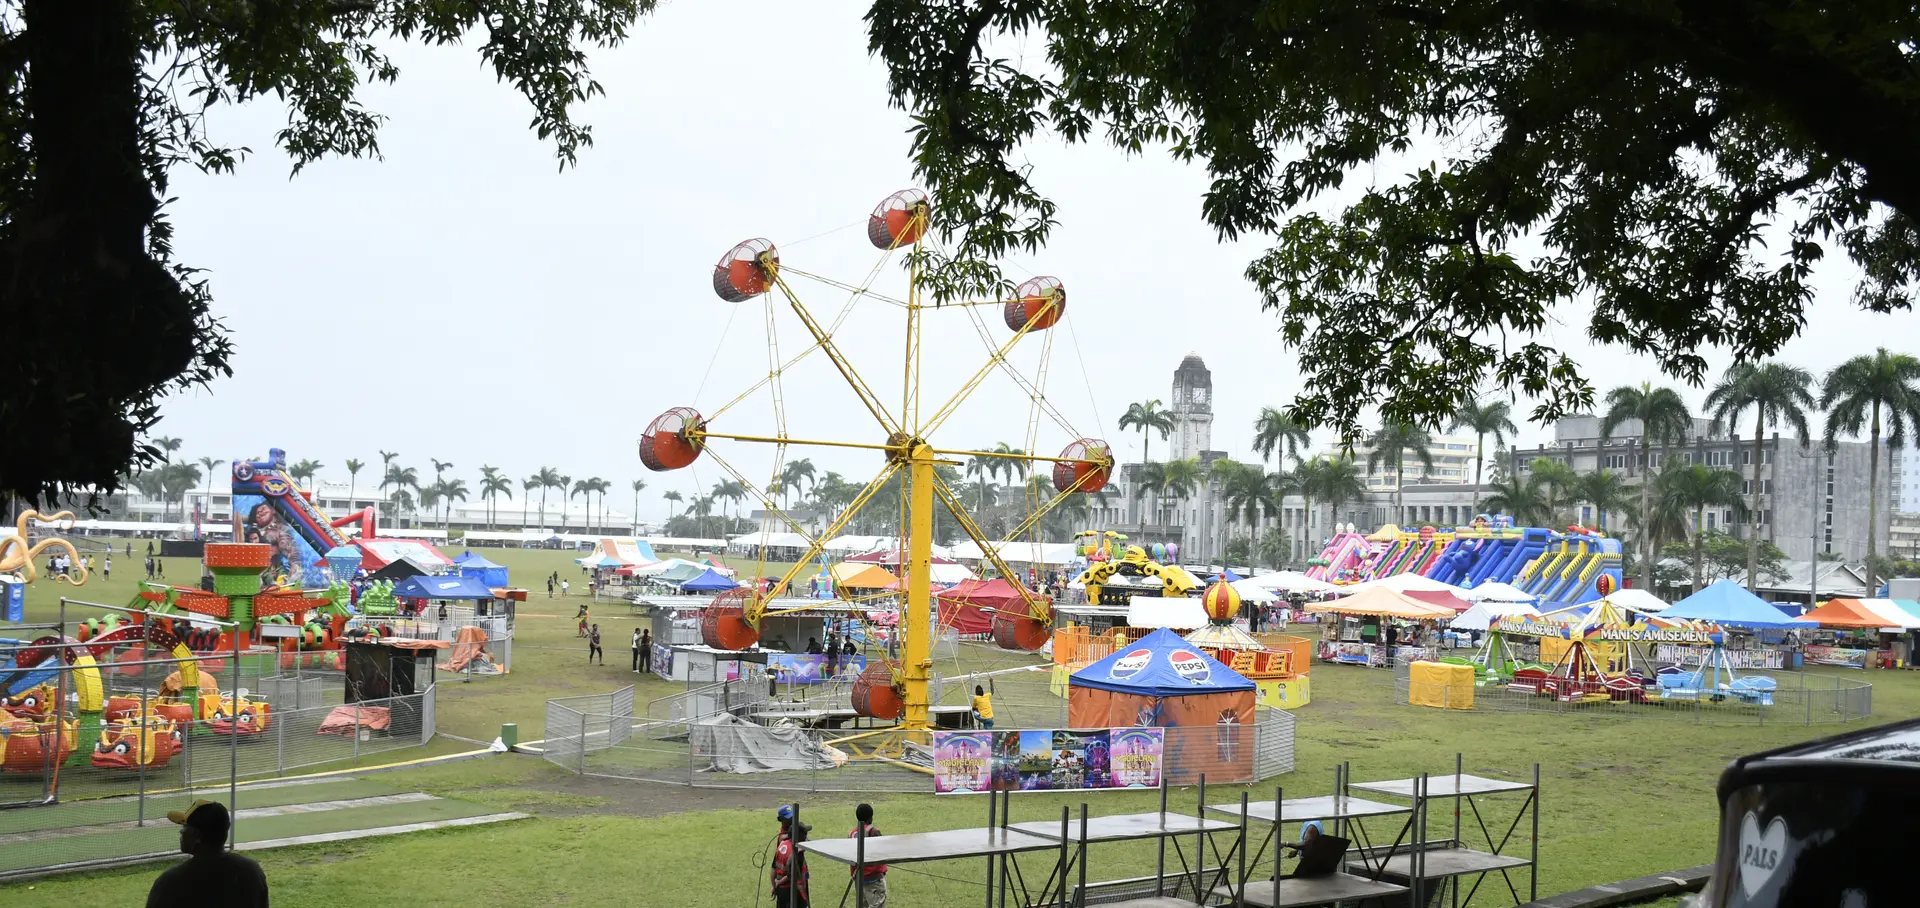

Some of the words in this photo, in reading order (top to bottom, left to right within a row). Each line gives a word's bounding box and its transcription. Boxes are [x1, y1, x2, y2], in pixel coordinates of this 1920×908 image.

[1498, 620, 1520, 632] MANI'S
[1522, 623, 1561, 636] AMUSEMENT
[1600, 628, 1641, 641] MANI'S
[1643, 630, 1710, 642] AMUSEMENT
[1175, 662, 1206, 671] PEPSI
[1743, 844, 1777, 870] PALS
